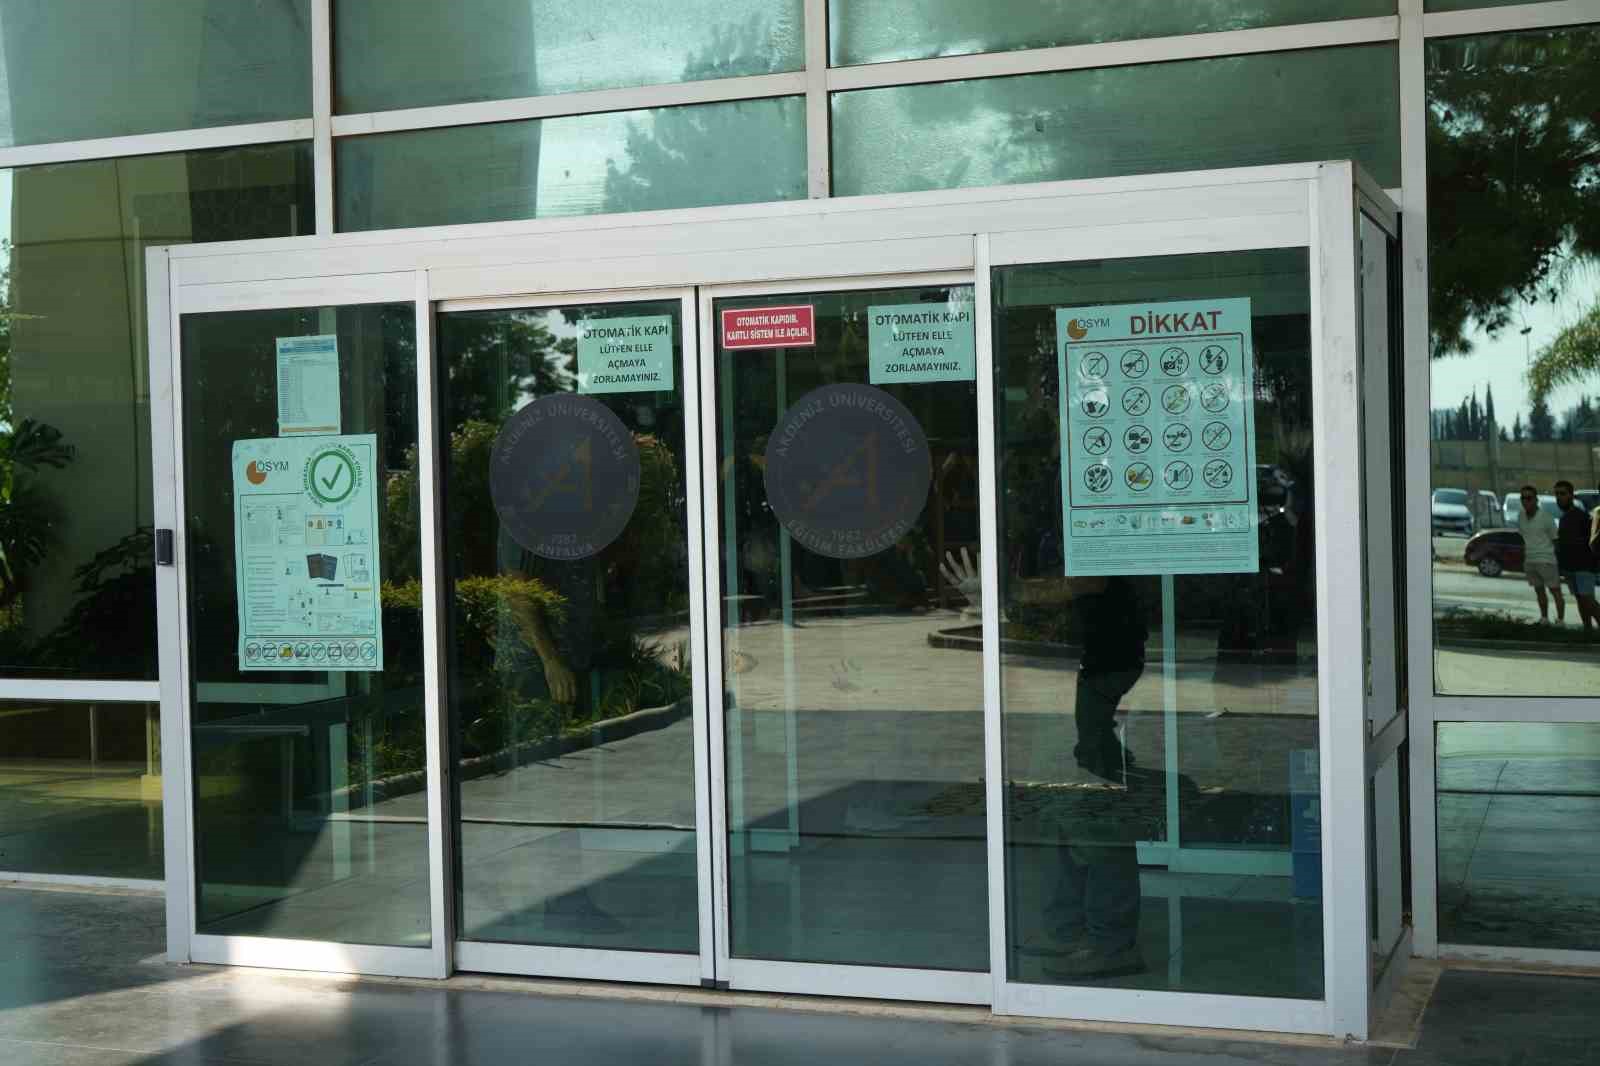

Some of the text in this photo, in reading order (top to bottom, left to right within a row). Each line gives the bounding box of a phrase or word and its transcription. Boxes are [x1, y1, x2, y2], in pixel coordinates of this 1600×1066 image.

[736, 314, 770, 326] OTOMATİK
[875, 311, 939, 326] OTOMATİK
[1130, 310, 1222, 335] DİKKAT
[584, 325, 668, 339] OTOMATİK KAPI
[751, 328, 773, 339] SİSTEM
[932, 331, 953, 340] ELLE
[635, 344, 653, 352] ELLE
[902, 347, 945, 358] AÇMAYA
[607, 359, 646, 370] AÇMAYA
[885, 361, 961, 373] ZORLAMAYINIZ.
